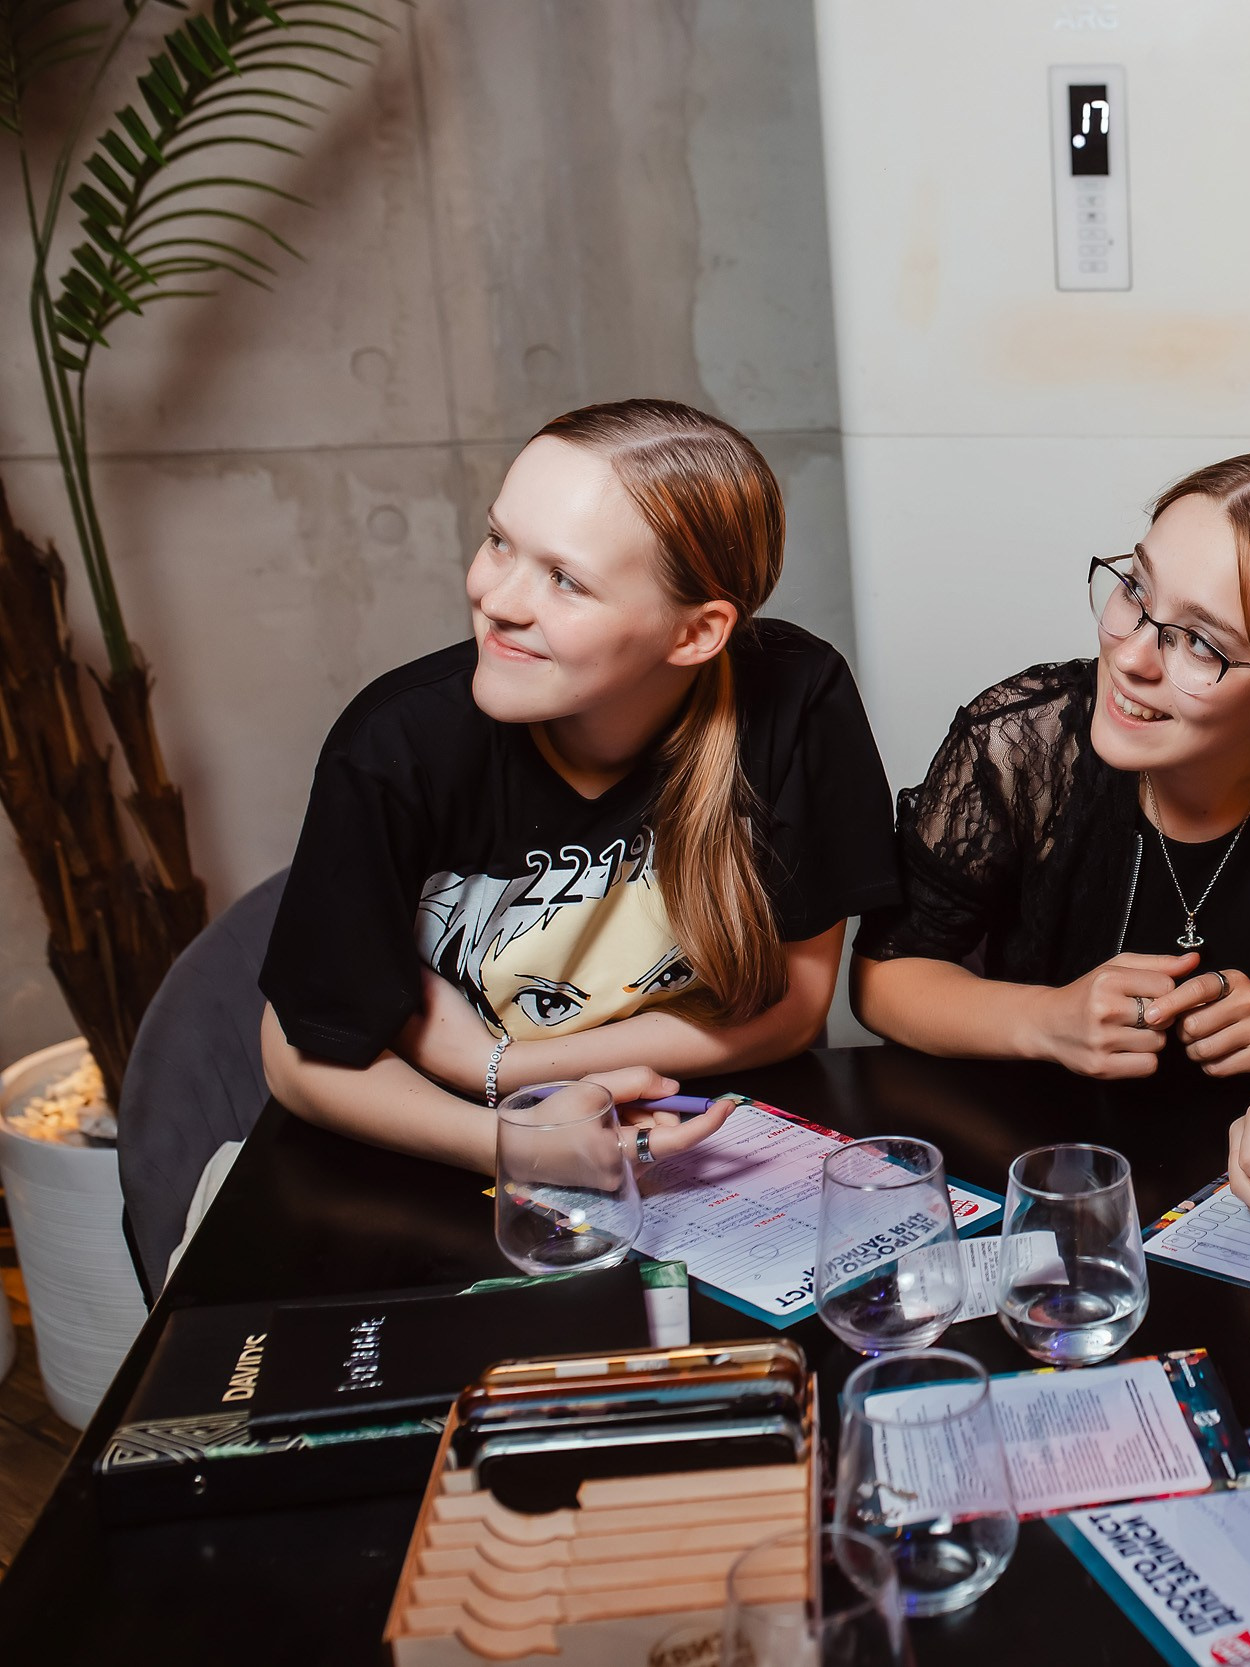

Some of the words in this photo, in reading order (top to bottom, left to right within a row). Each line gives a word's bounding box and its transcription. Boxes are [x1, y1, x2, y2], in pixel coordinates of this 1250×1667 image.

[1088, 1513, 1146, 1558] ЛИСТ
[1124, 1515, 1200, 1586] ЗАПИСИ
[1133, 1559, 1214, 1637] ПРОСТО
[1189, 1585, 1244, 1627] ДЛЯ
